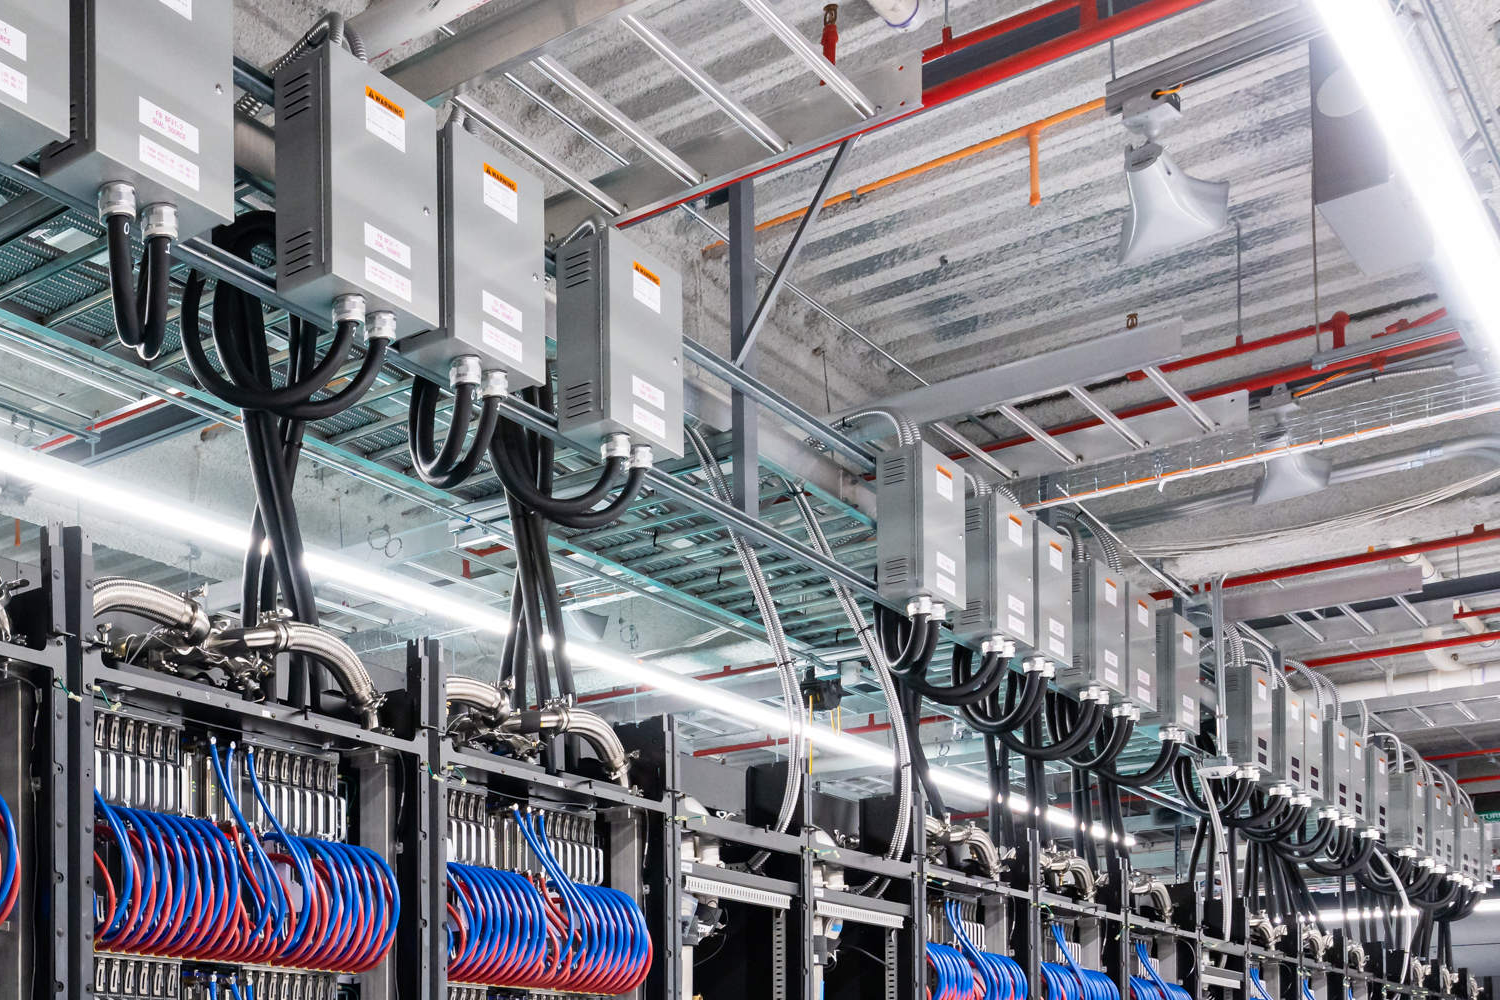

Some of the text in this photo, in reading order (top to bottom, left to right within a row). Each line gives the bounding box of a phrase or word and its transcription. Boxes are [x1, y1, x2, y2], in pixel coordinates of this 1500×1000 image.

[156, 110, 162, 118] FB
[375, 94, 403, 118] WARNING
[152, 117, 186, 140] DUAL SOURCE
[492, 170, 516, 191] WARNING
